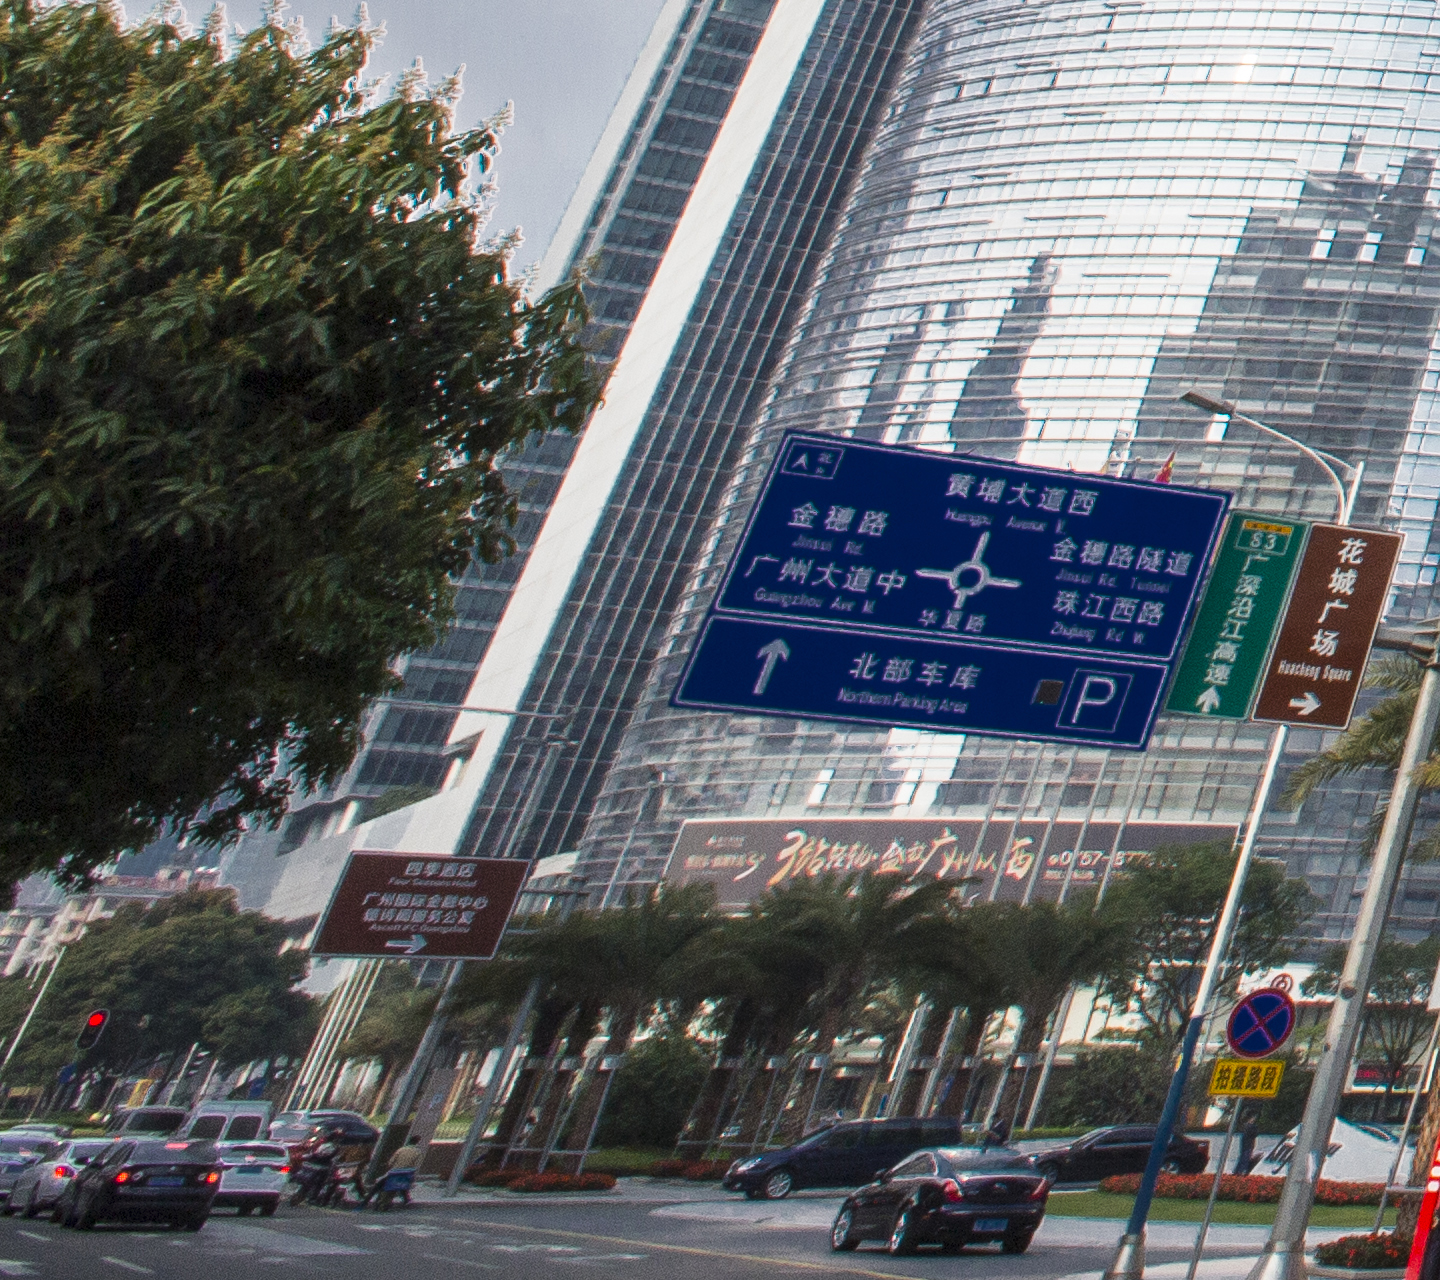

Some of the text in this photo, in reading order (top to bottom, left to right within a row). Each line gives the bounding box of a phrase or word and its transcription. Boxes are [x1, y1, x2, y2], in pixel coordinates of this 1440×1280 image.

[945, 472, 1099, 517] 黄埔大道西
[787, 500, 890, 538] 金穗路
[743, 553, 908, 596] 广州大道中
[1049, 536, 1194, 576] 金穗路隧道
[753, 587, 824, 608] Guangzhou
[1053, 589, 1165, 627] 珠江西路
[1309, 537, 1368, 658] 花城广场
[918, 608, 987, 634] 华夏路
[1203, 552, 1272, 686] 广深沿江高速
[849, 651, 983, 690] 北部车库
[1278, 659, 1353, 683] Huacheng Square
[837, 686, 891, 707] Northern
[892, 690, 938, 714] Parking
[1072, 674, 1117, 725] P
[405, 861, 478, 878] 四季酒店
[361, 892, 489, 910] 广州国际金融中心
[1216, 1065, 1278, 1091] 拍摄路段
